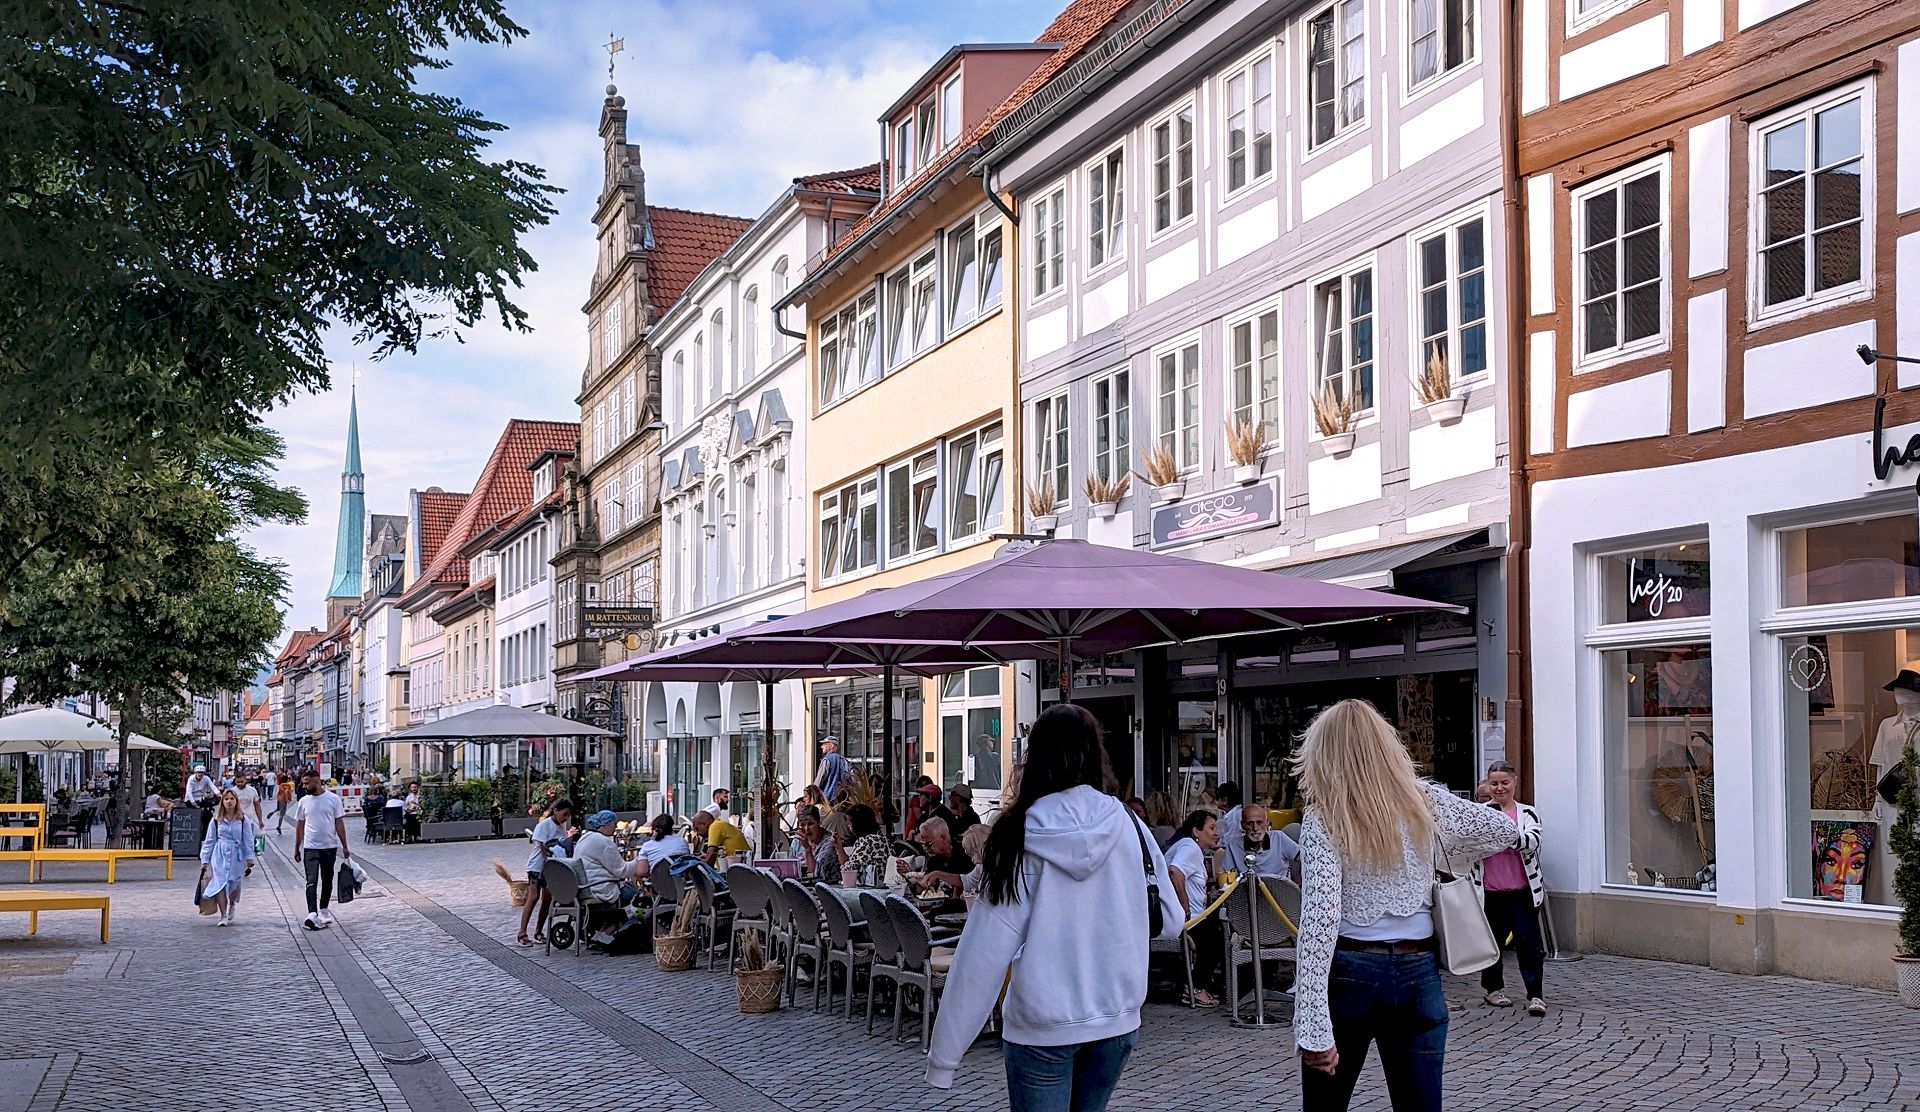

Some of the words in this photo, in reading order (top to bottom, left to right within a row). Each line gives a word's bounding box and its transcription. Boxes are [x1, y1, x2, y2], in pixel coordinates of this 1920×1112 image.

[1190, 495, 1235, 514] diego
[1203, 516, 1249, 531] EISMANUFAKTUR
[1630, 557, 1672, 617] hej
[1667, 585, 1683, 603] 20
[1216, 679, 1226, 696] 19
[991, 718, 1000, 737] 18
